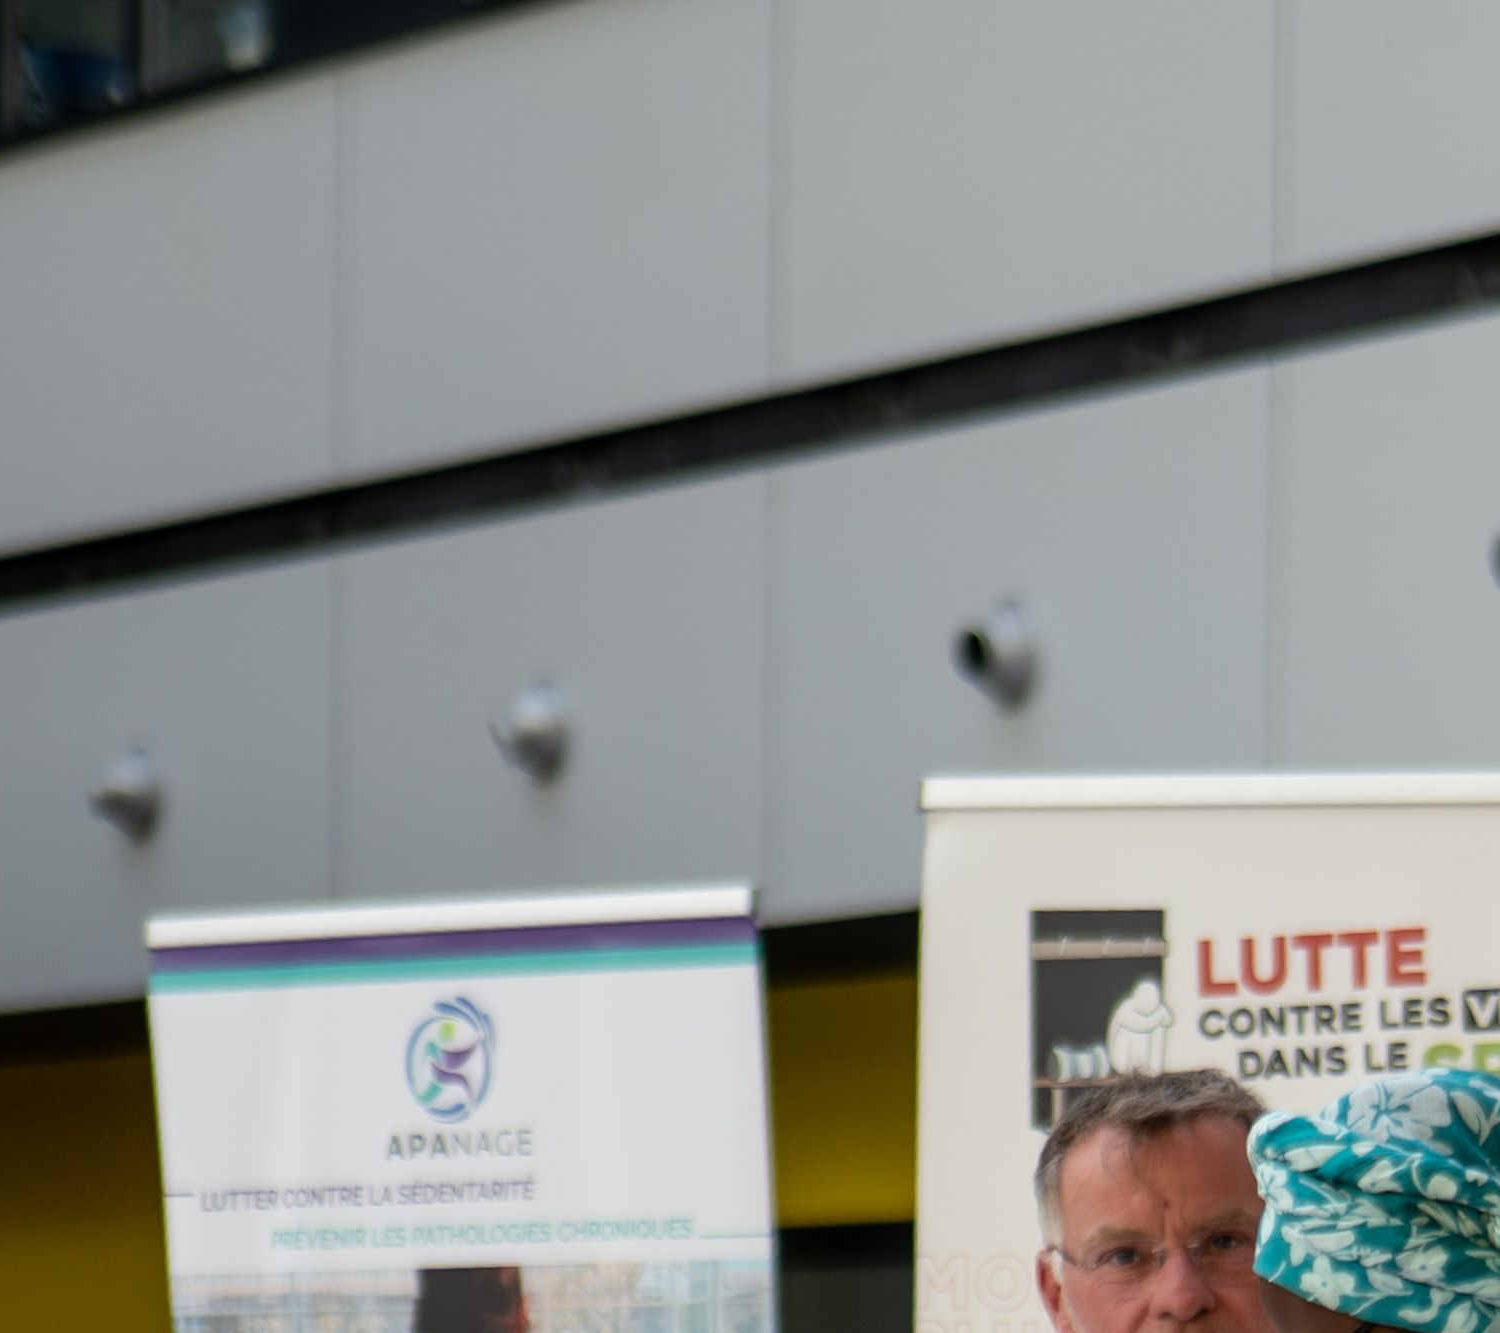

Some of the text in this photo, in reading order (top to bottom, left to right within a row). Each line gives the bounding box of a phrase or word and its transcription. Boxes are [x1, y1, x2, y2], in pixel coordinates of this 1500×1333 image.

[1196, 927, 1427, 998] LUTTE
[1199, 1002, 1361, 1041] CONTRE
[1381, 998, 1452, 1032] LES
[1238, 1045, 1351, 1080] DANS
[1366, 1042, 1408, 1073] LE
[386, 1129, 533, 1161] APANAGE
[201, 1176, 535, 1213] LUTTER CONTRE LA SÉDENTARITÉ
[371, 1225, 408, 1249] LES
[412, 1219, 552, 1247] PATHOLOGIES
[557, 1217, 694, 1243] CHRONIQUES
